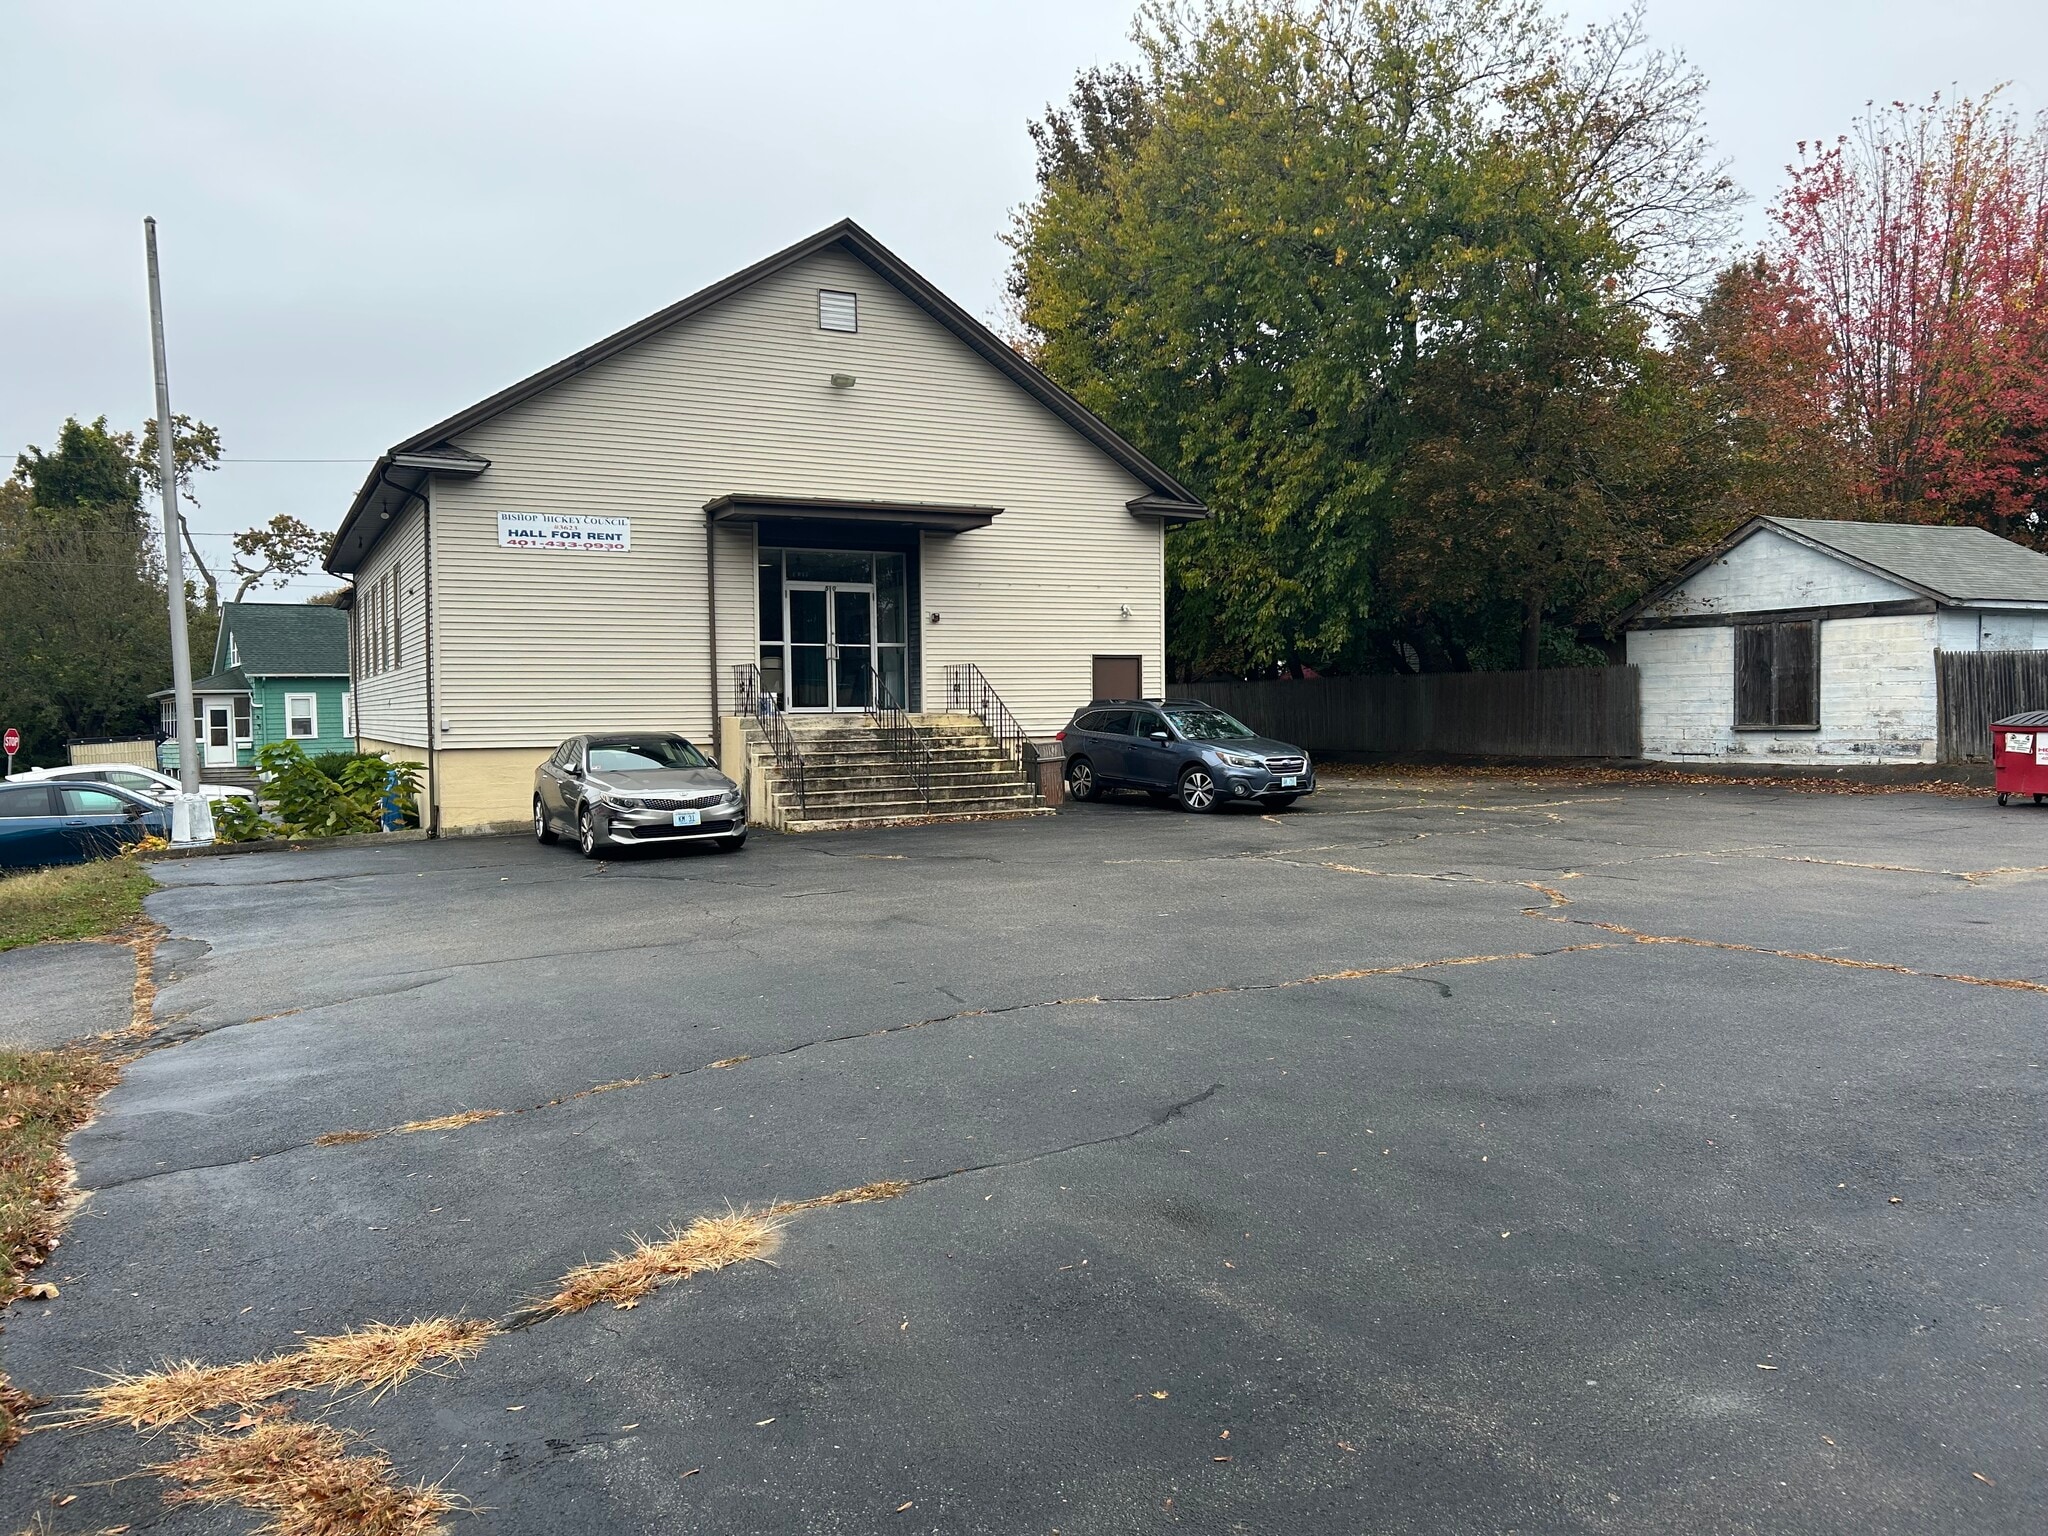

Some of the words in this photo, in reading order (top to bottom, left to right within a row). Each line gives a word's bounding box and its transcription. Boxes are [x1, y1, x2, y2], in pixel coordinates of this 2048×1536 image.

[501, 513, 538, 522] BISHOP
[543, 515, 582, 524] HICKEY
[584, 516, 628, 526] COUNCIL
[508, 529, 547, 538] HALL
[551, 530, 581, 540] FOR
[587, 532, 623, 541] RENT
[507, 540, 624, 549] 401-433-0930
[5, 736, 18, 747] STOP
